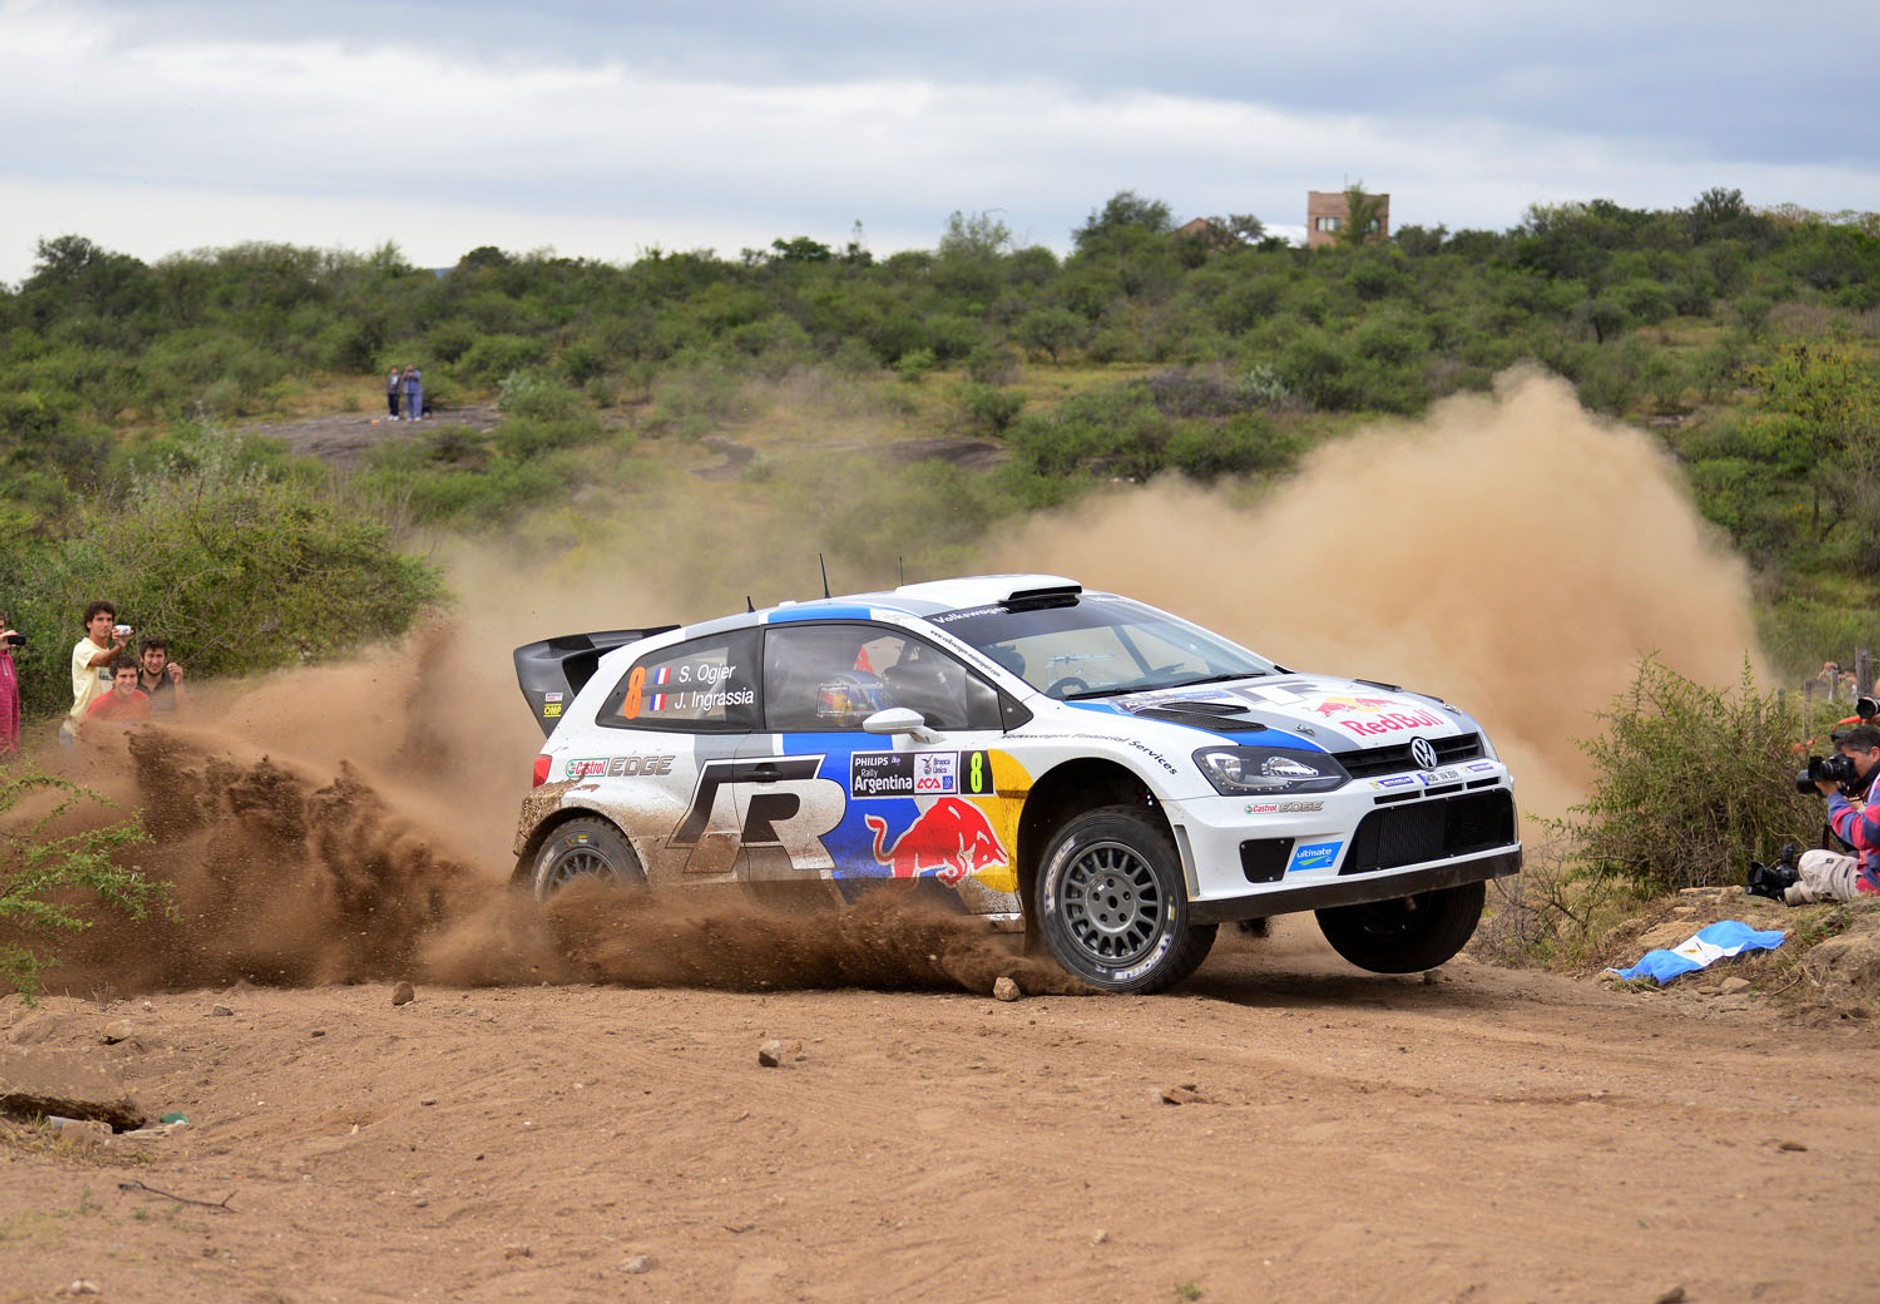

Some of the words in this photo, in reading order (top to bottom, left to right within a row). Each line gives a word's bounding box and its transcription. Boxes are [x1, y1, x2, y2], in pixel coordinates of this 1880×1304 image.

[679, 666, 692, 682] S.
[697, 663, 736, 687] Ogier
[624, 666, 646, 720] 8
[674, 695, 689, 710] J.
[692, 687, 755, 712] Ingrassia
[543, 704, 562, 716] OMP
[576, 761, 606, 775] Castrol
[608, 755, 674, 777] EDGE
[854, 757, 889, 767] PHILIPS
[1128, 739, 1178, 776] Services
[861, 768, 878, 778] Rally
[970, 751, 983, 793] 8
[854, 775, 913, 793] Argentina
[917, 778, 941, 789] ACA
[1253, 804, 1278, 813] Castrol
[1280, 801, 1325, 813] EDGE
[1296, 848, 1333, 858] ultimate
